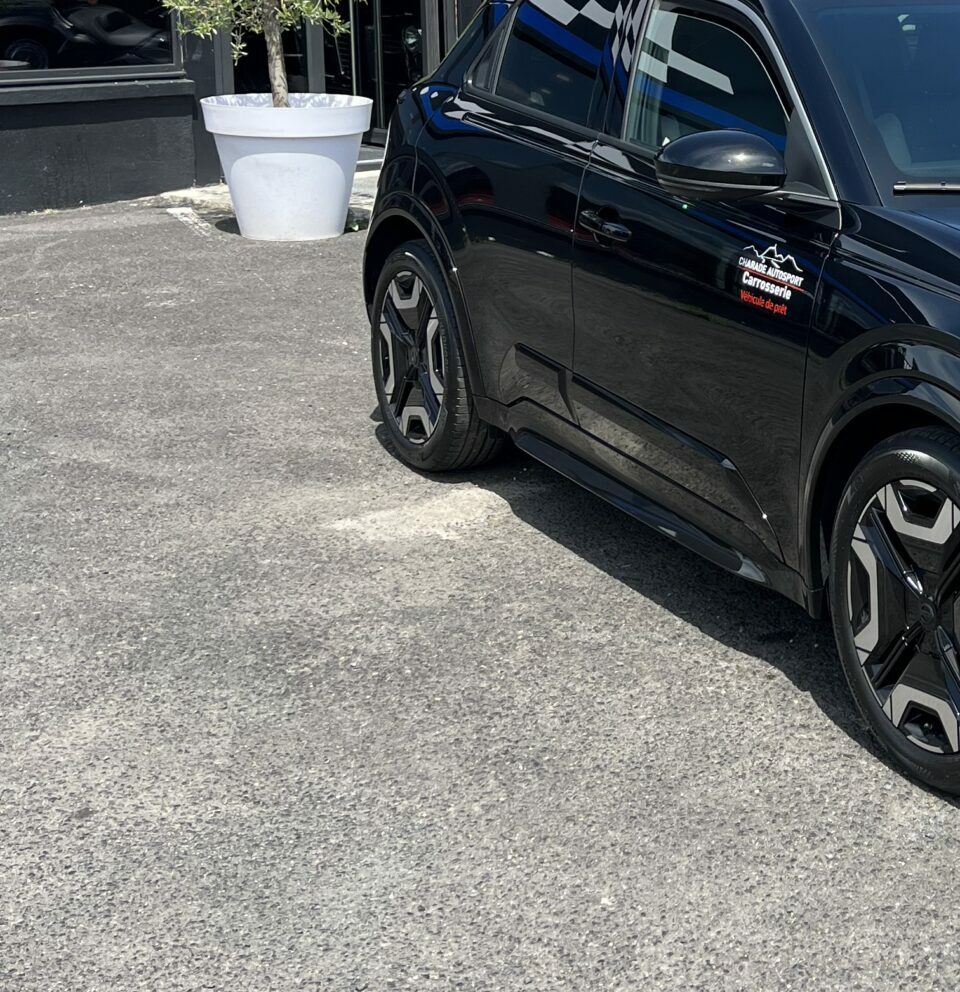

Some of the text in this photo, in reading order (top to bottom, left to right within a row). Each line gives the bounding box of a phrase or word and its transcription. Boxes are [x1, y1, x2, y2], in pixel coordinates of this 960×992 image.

[738, 256, 804, 287] CHARADE AUTOSPORT
[742, 271, 792, 300] Carrosserie
[765, 299, 774, 310] de
